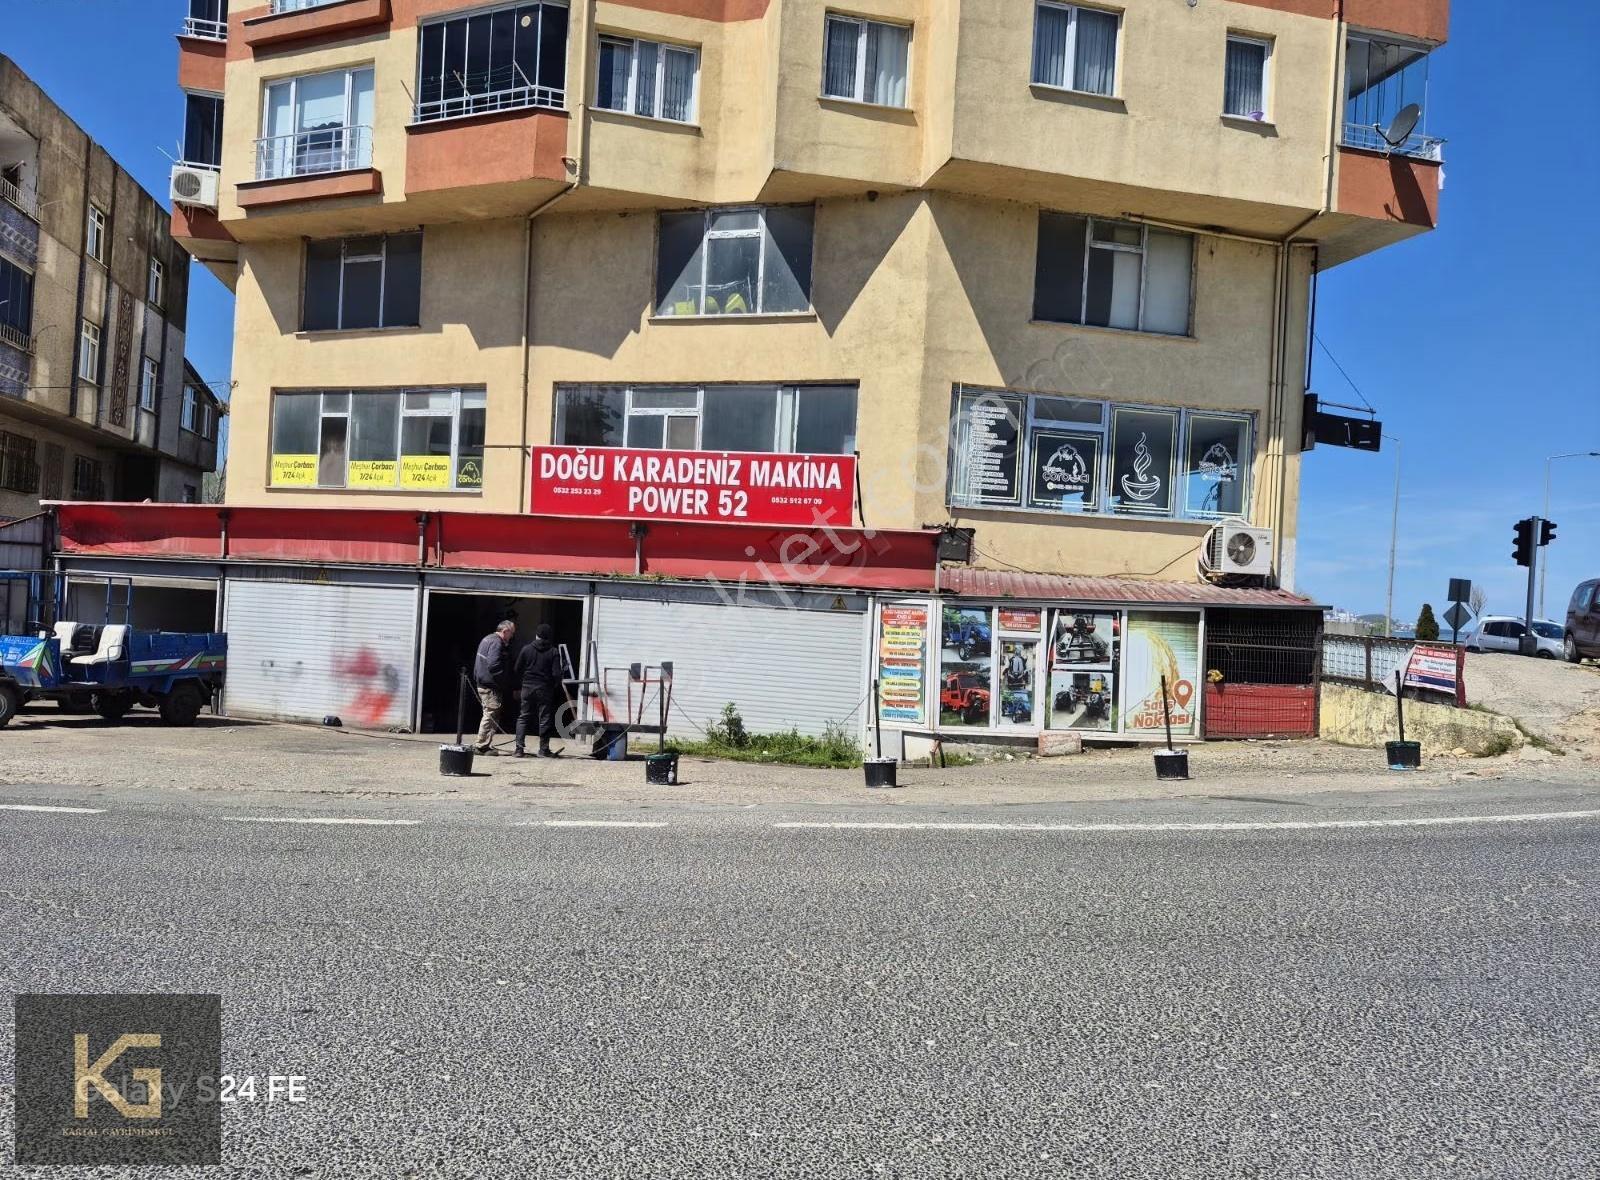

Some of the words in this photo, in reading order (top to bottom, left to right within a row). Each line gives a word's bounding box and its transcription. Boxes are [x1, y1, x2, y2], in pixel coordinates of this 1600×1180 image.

[540, 447, 604, 481] DOĞU
[613, 452, 741, 486] KARADENİZ
[750, 455, 842, 490] MAKİNA
[282, 471, 295, 479] 7/24
[359, 473, 373, 481] 7/24
[412, 473, 425, 481] 7/24
[553, 486, 570, 494] 0532
[629, 486, 709, 515] POWER
[718, 489, 748, 517] 52
[1143, 699, 1174, 711] Satş
[1134, 712, 1190, 728] Nokası
